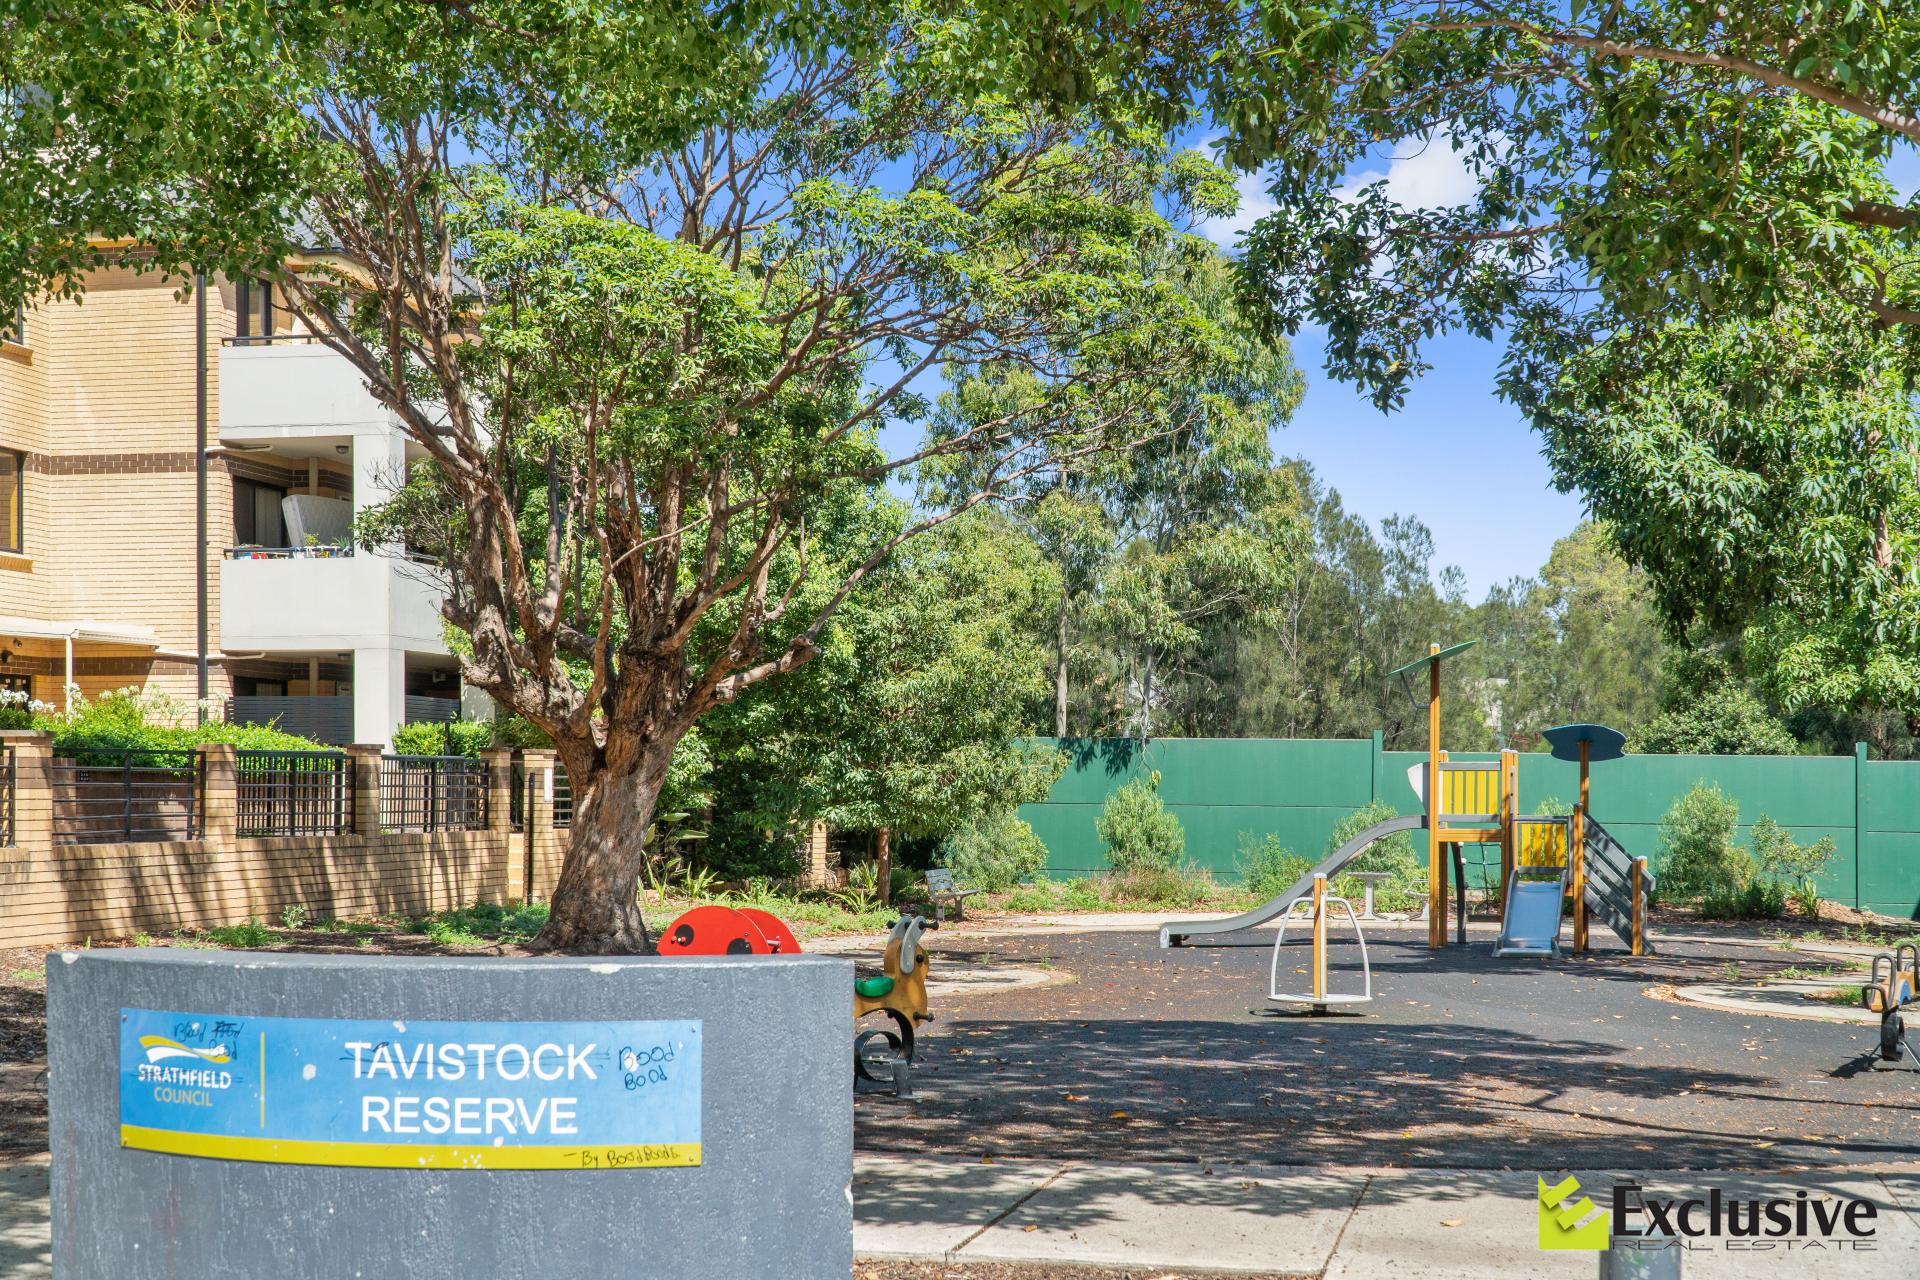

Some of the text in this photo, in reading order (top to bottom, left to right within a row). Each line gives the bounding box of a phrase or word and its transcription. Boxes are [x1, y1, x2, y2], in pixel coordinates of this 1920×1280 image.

[138, 1064, 232, 1089] STRATHFIELD
[345, 1042, 597, 1080] TAVISTOCK
[154, 1087, 213, 1107] COUNCIL
[361, 1097, 578, 1135] RESERVE
